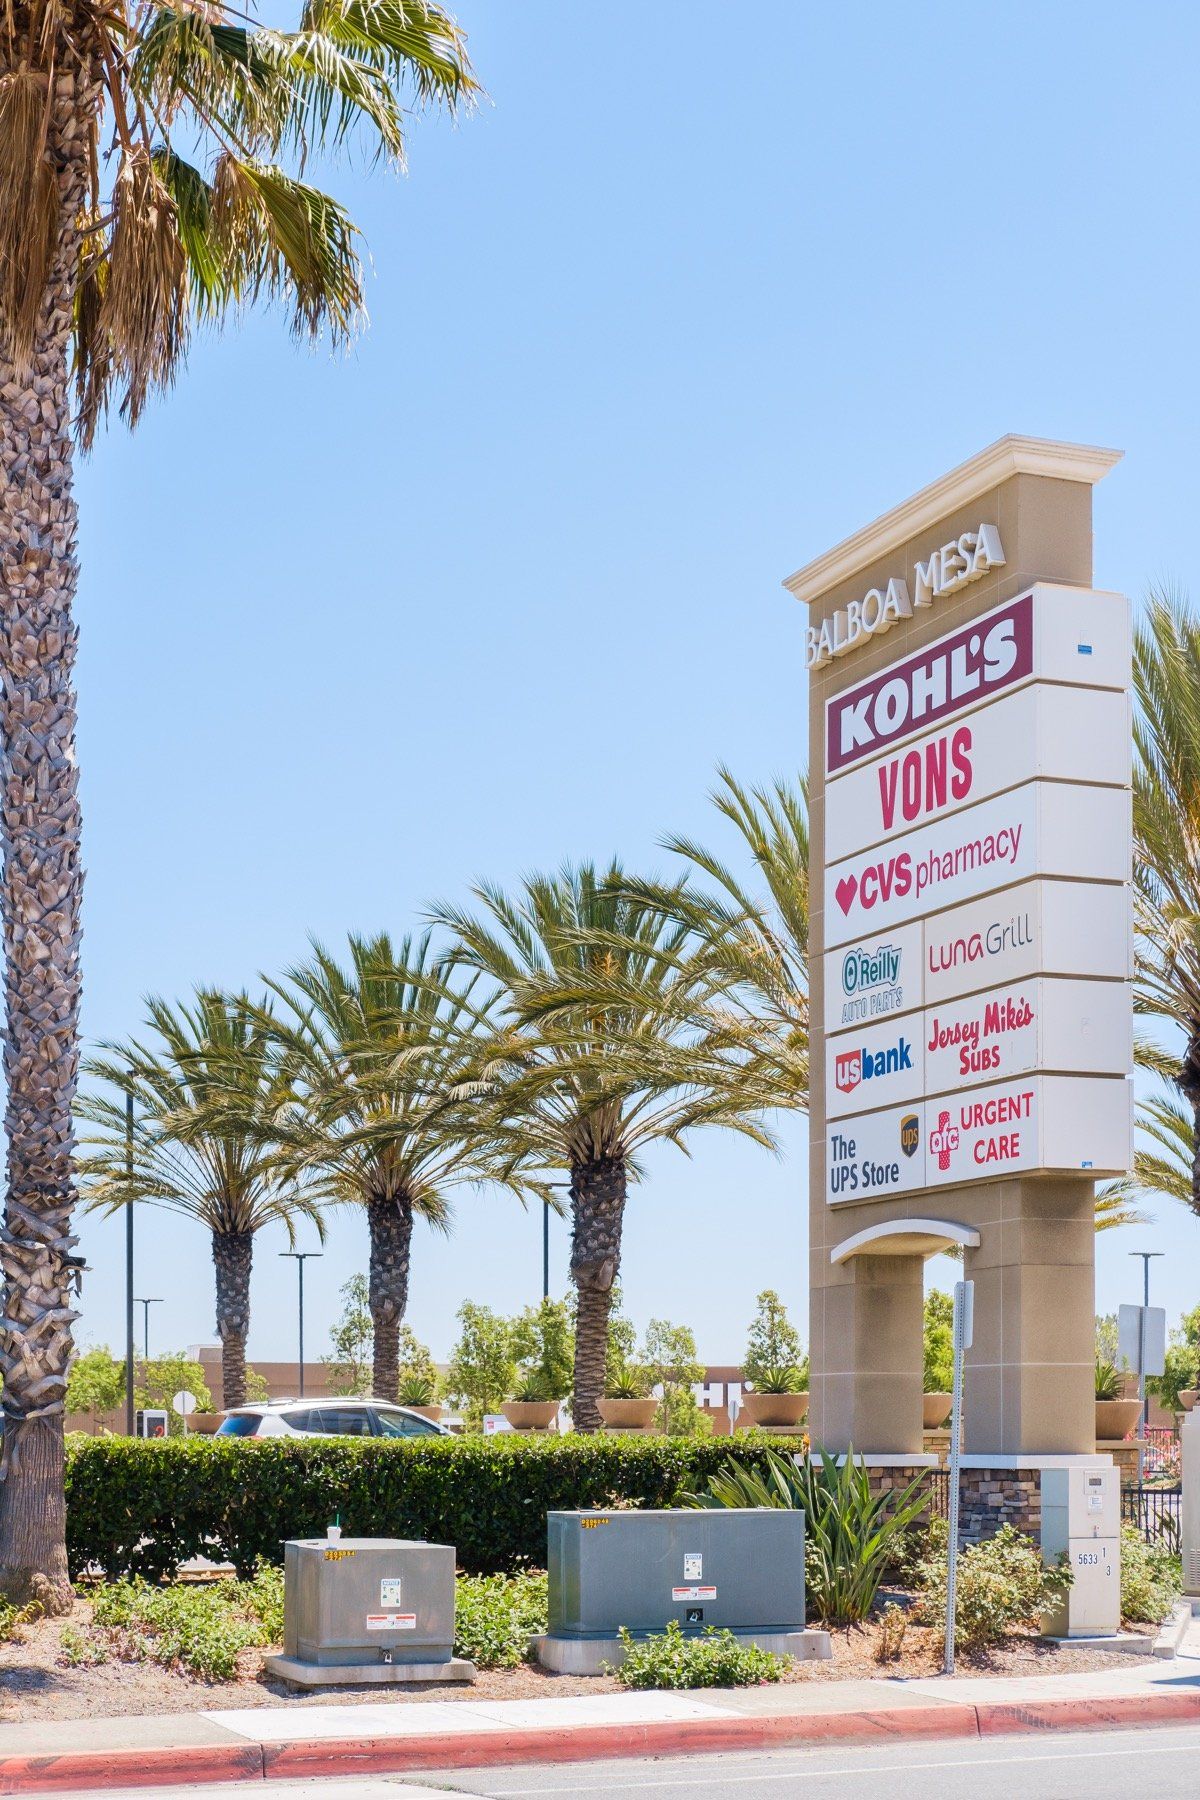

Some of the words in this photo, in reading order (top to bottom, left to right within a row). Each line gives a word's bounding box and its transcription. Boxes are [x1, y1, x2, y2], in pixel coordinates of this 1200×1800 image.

[805, 578, 913, 670] BALBOA
[914, 523, 1006, 608] MESA
[841, 618, 1017, 756] KOHL'S
[878, 726, 973, 831] VONS
[860, 853, 912, 910] CVS
[916, 824, 1022, 899] pharmacy
[843, 949, 900, 993] O'Reilly
[841, 997, 867, 1024] AUTO
[870, 986, 903, 1015] PARTS
[928, 1019, 980, 1051] Jersey
[984, 997, 1035, 1037] Mike's
[961, 1091, 1034, 1130] URGENT
[831, 1134, 856, 1161] The
[973, 1133, 1020, 1165] CARE
[831, 1163, 858, 1193] UPS
[862, 1161, 899, 1188] Store
[1078, 1553, 1098, 1564] 5633
[1102, 1547, 1106, 1558] 1
[1106, 1565, 1111, 1576] 3
